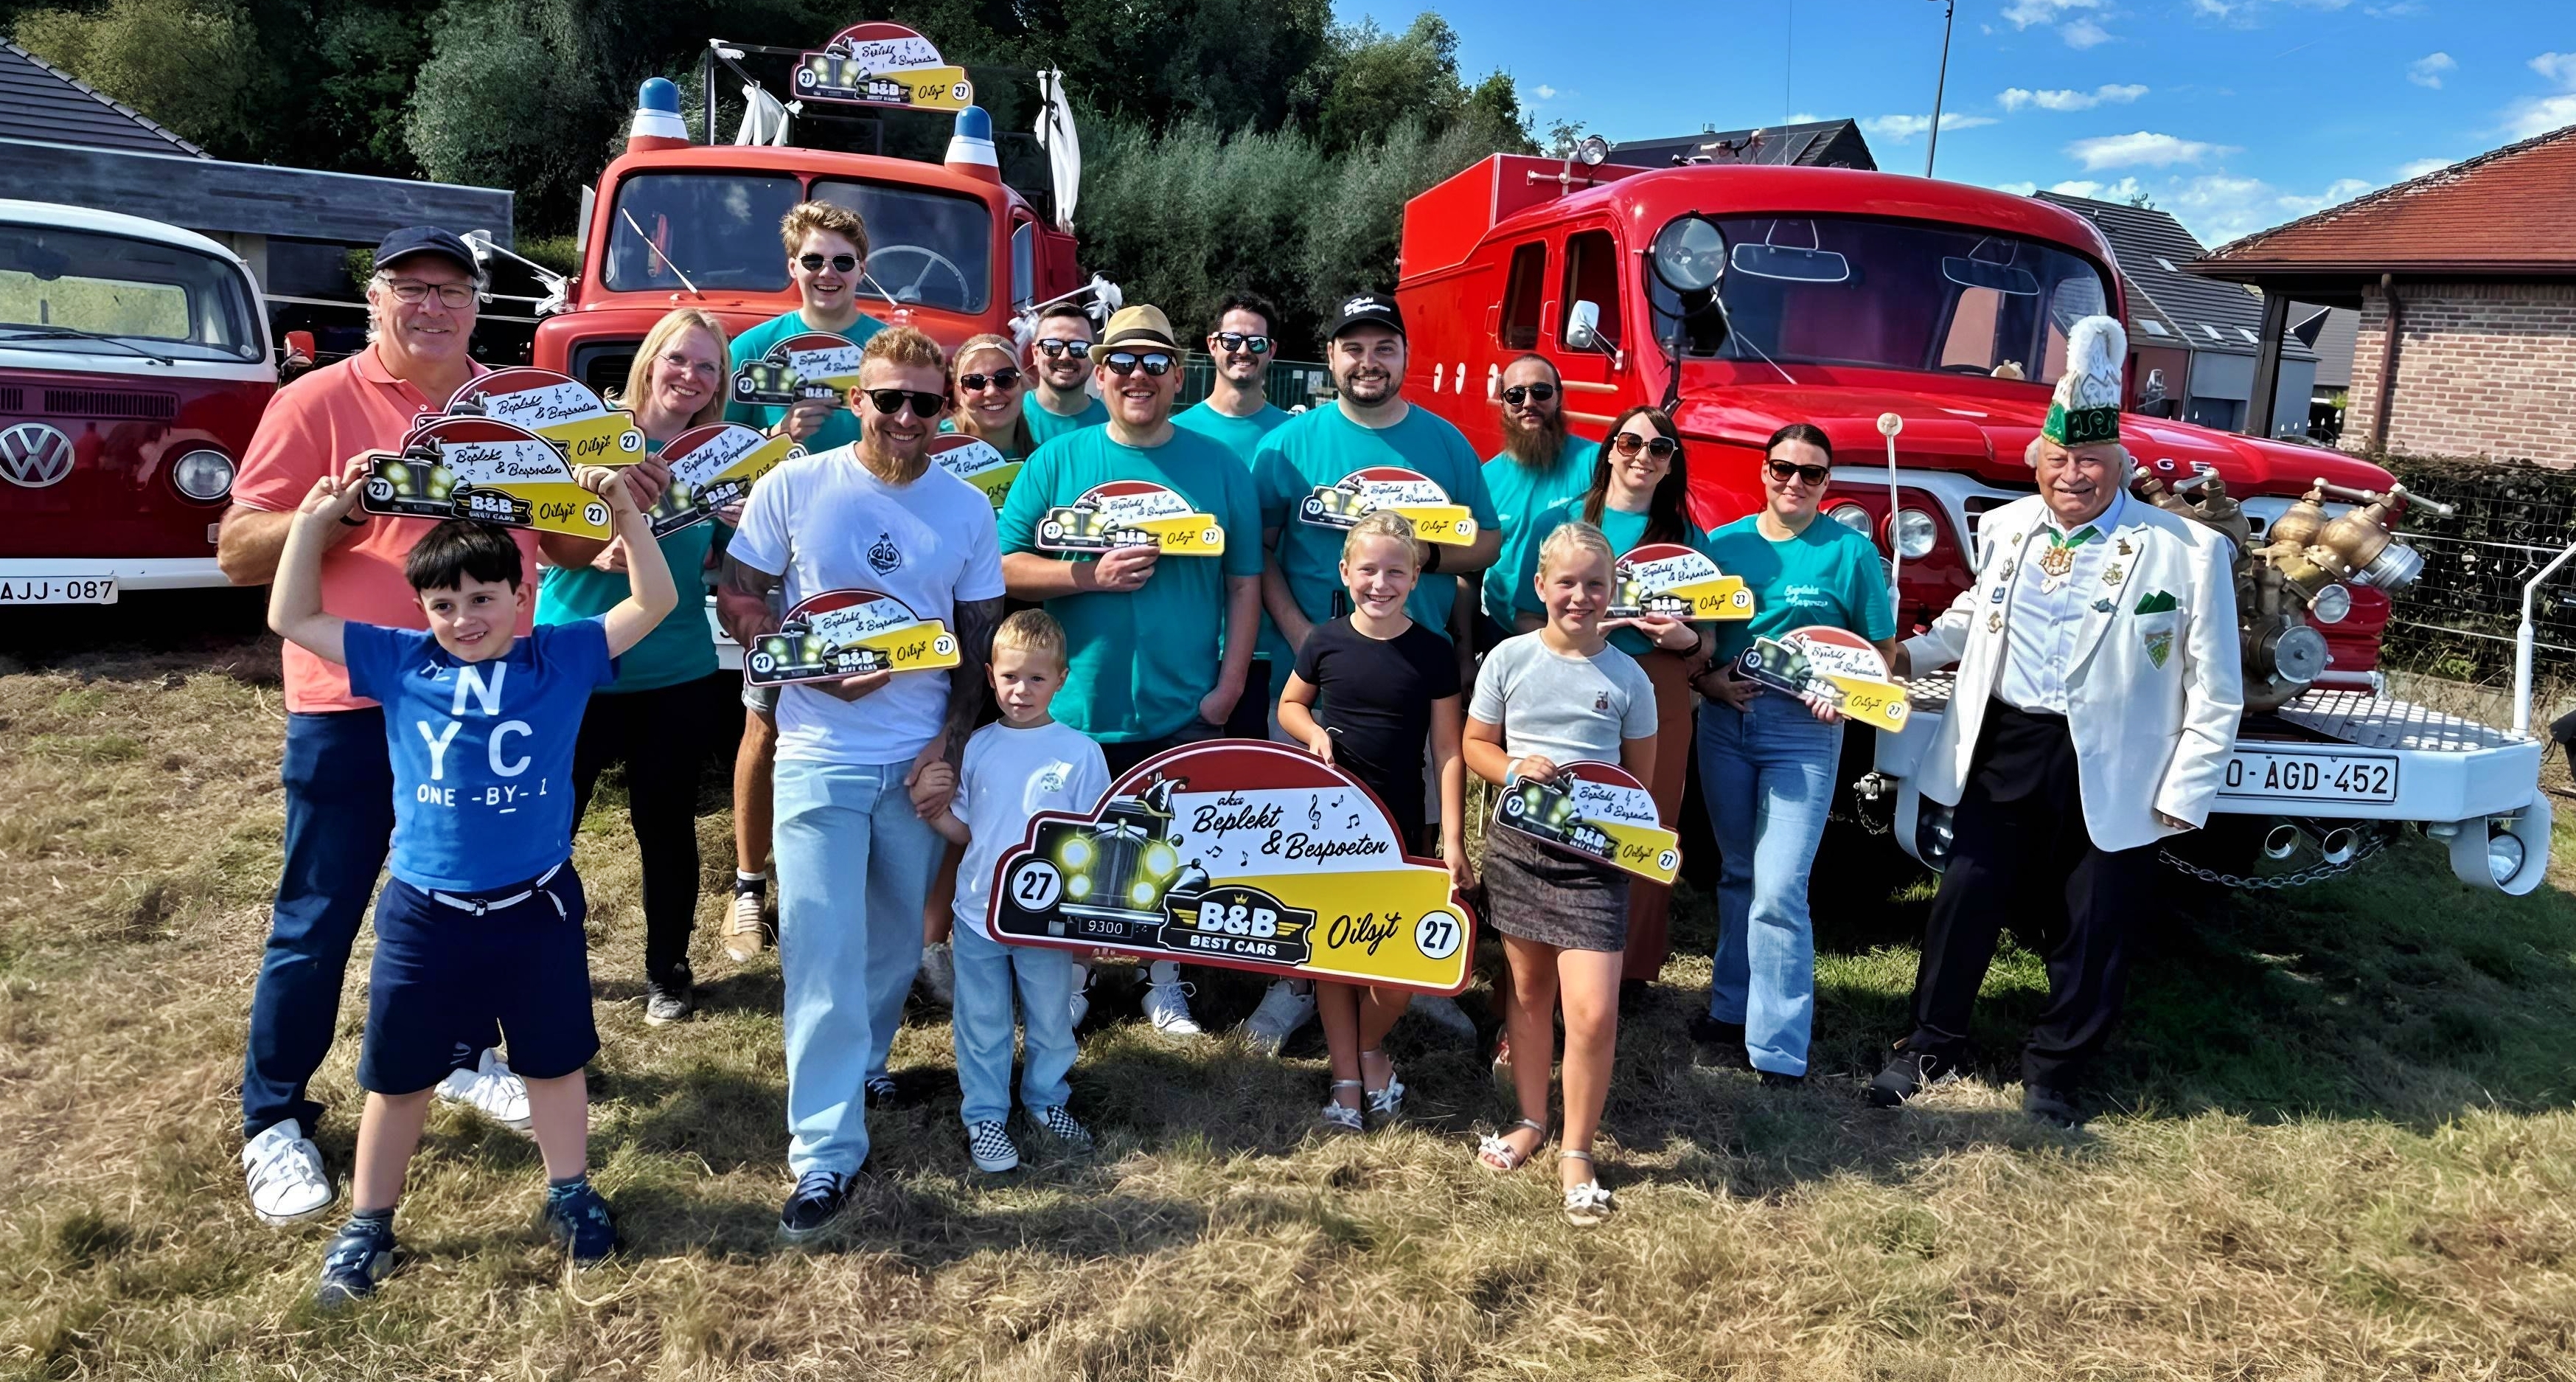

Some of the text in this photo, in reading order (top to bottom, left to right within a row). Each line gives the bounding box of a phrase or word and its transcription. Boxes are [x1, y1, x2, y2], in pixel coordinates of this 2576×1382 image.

[371, 482, 388, 497] 27
[470, 495, 513, 513] B&B
[417, 784, 456, 807] ONE
[1192, 802, 1284, 839] Beplekt
[1261, 830, 1390, 866] & Bespoeten
[1020, 871, 1054, 900] 27
[1087, 920, 1123, 934] 9300
[1197, 900, 1277, 939] B&B
[1190, 935, 1277, 956] BEST CARS
[1423, 920, 1452, 950] 27
